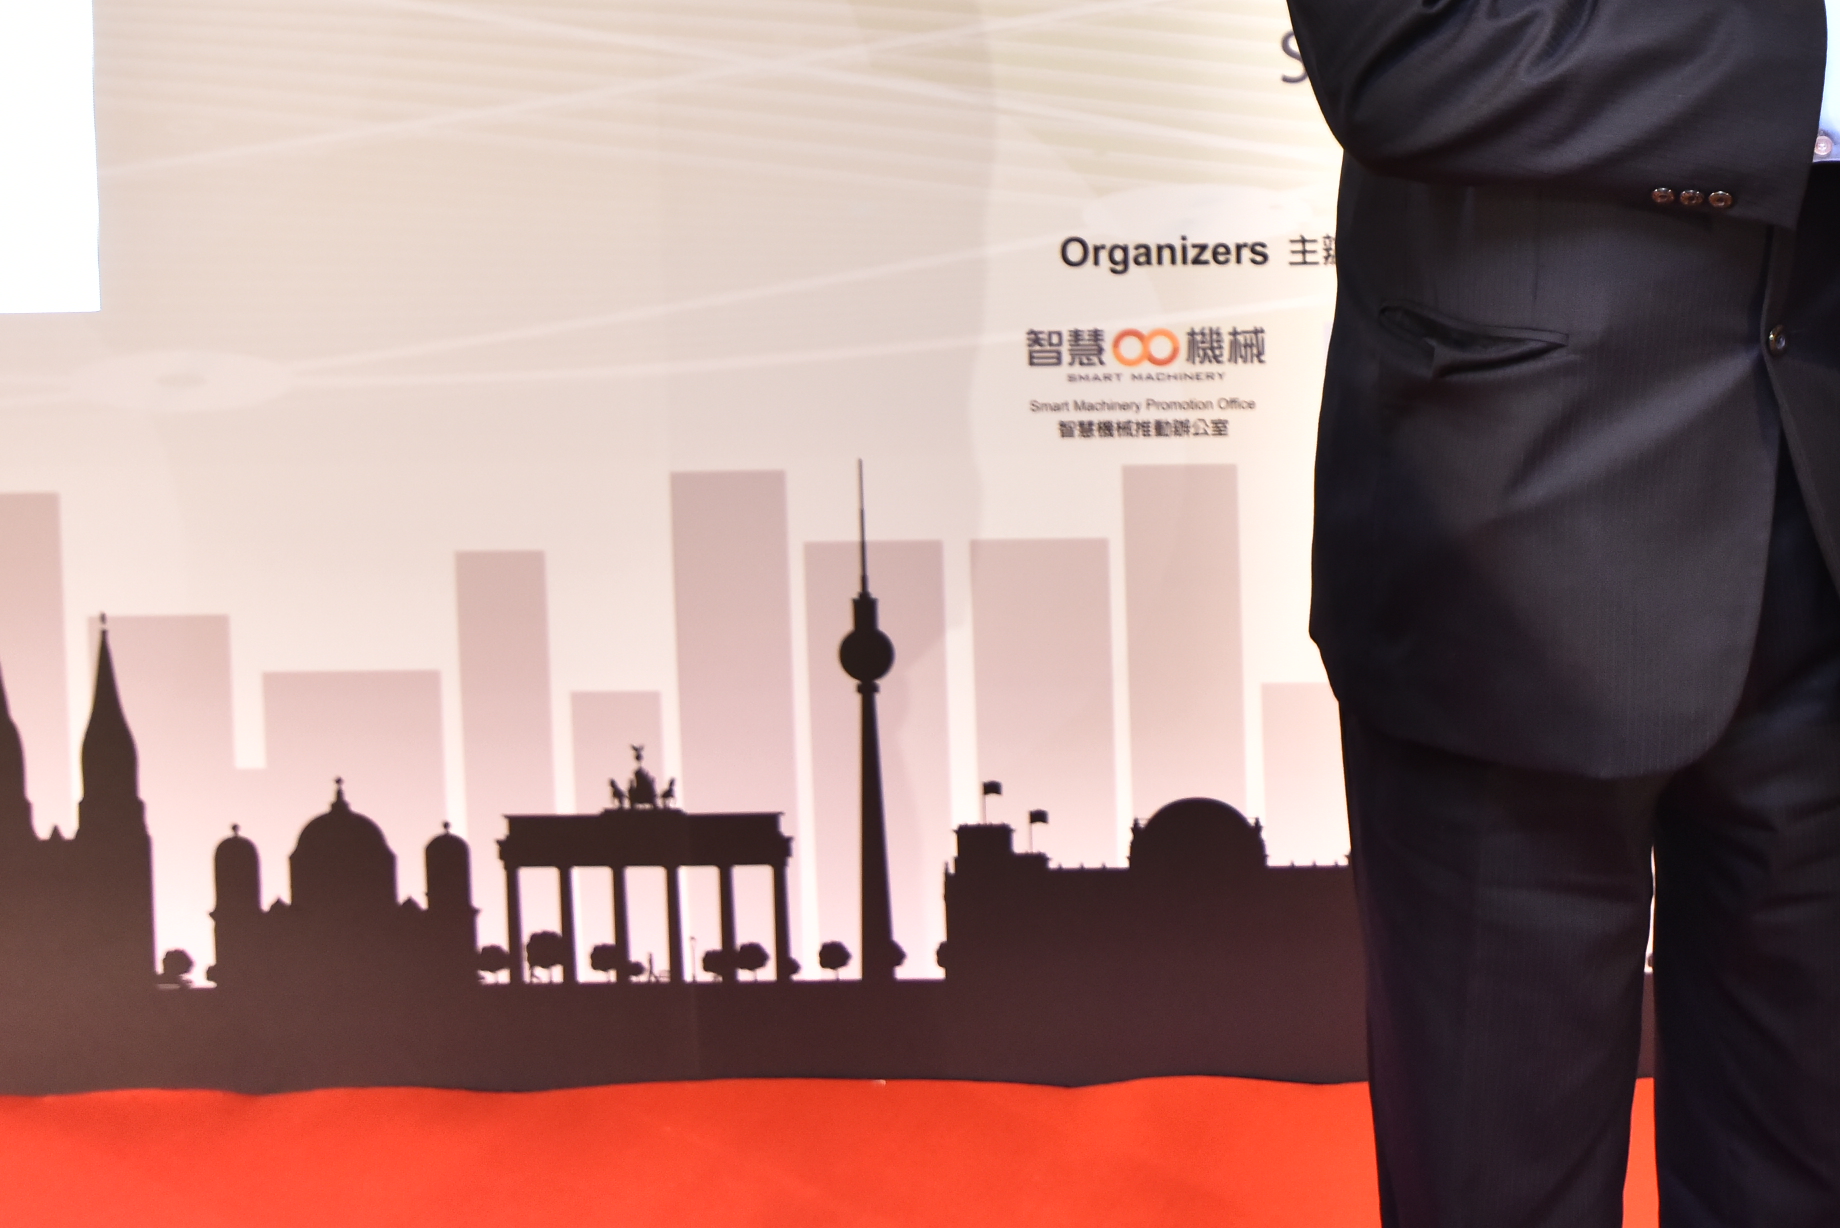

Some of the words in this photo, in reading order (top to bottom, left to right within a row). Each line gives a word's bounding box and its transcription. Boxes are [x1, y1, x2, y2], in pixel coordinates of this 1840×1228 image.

[1060, 235, 1270, 275] Organizers
[1066, 371, 1124, 383] SMART
[1130, 370, 1227, 383] MACHINERY
[1029, 398, 1071, 414] Smart
[1073, 397, 1142, 415] Machinery
[1145, 397, 1214, 413] Promotion
[1217, 395, 1257, 412] Office
